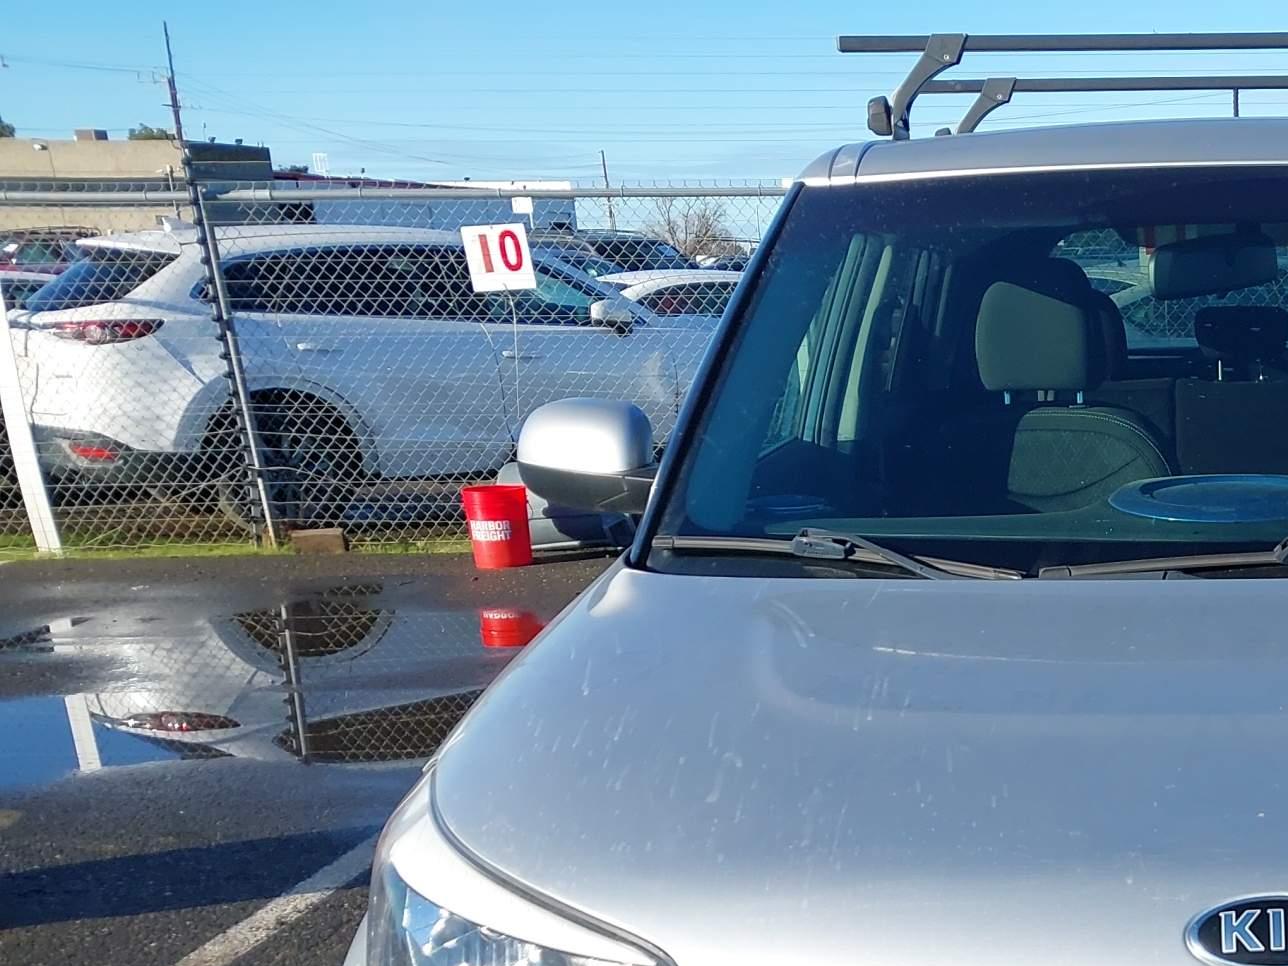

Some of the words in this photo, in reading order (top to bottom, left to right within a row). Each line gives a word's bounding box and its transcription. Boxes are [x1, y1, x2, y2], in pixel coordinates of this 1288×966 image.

[478, 230, 524, 273] 10
[470, 520, 511, 531] HARBOR
[472, 530, 512, 541] FREIGHT
